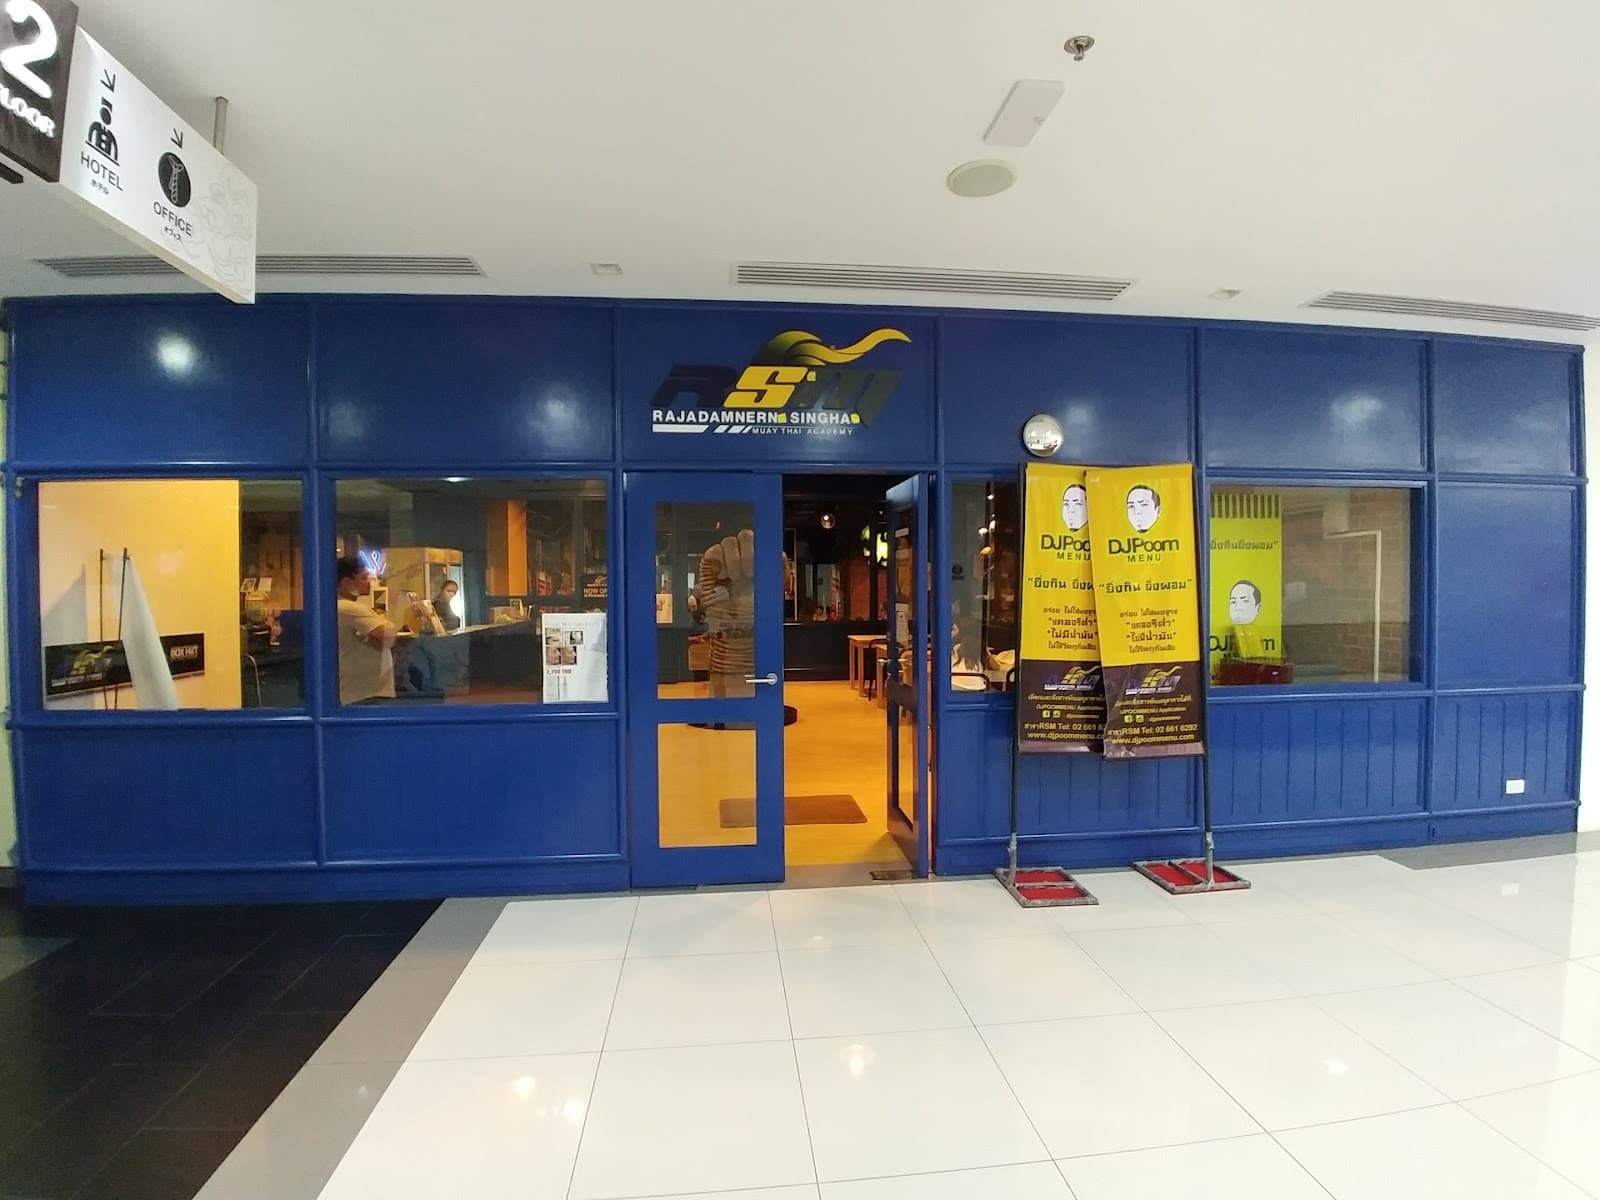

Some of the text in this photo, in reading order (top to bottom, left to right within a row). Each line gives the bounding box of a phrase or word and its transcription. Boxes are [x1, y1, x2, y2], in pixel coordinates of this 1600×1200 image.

[0, 0, 57, 98] 2
[0, 83, 55, 138] LOOR
[80, 151, 123, 191] HOTEL
[153, 201, 192, 236] OFFICE
[652, 409, 850, 425] RAJADAMNERN SINGHA
[752, 427, 853, 436] MUAY THAI ACADEMY
[1041, 534, 1091, 552] DJPoo
[1108, 538, 1179, 554] DJPoom
[1056, 552, 1091, 561] MENU
[1127, 554, 1160, 562] MENU
